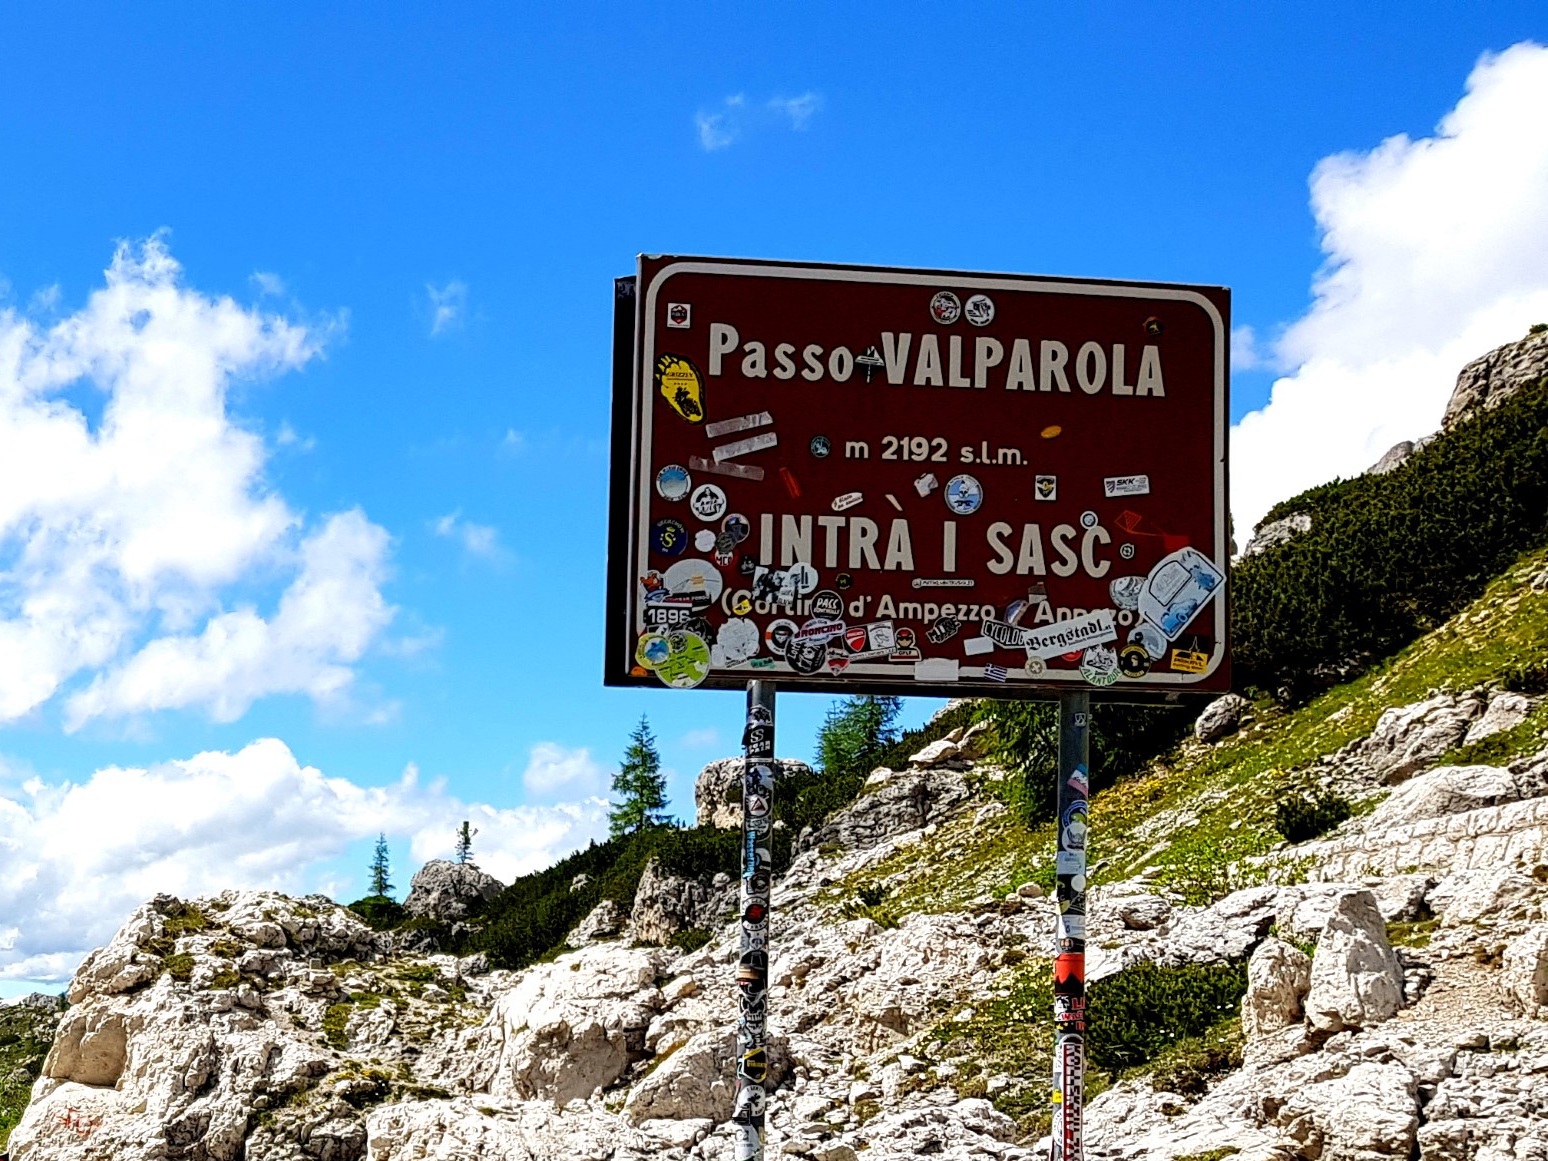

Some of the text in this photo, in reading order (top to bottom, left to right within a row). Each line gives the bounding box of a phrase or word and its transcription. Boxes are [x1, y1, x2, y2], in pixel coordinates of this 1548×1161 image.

[708, 322, 1165, 397] Passo VALPAROLA
[845, 435, 1028, 465] m 2192 s.l.m.
[759, 494, 915, 571] INTRÀ
[943, 520, 957, 572] I
[647, 608, 691, 624] 1896
[721, 587, 812, 617] (Cortin
